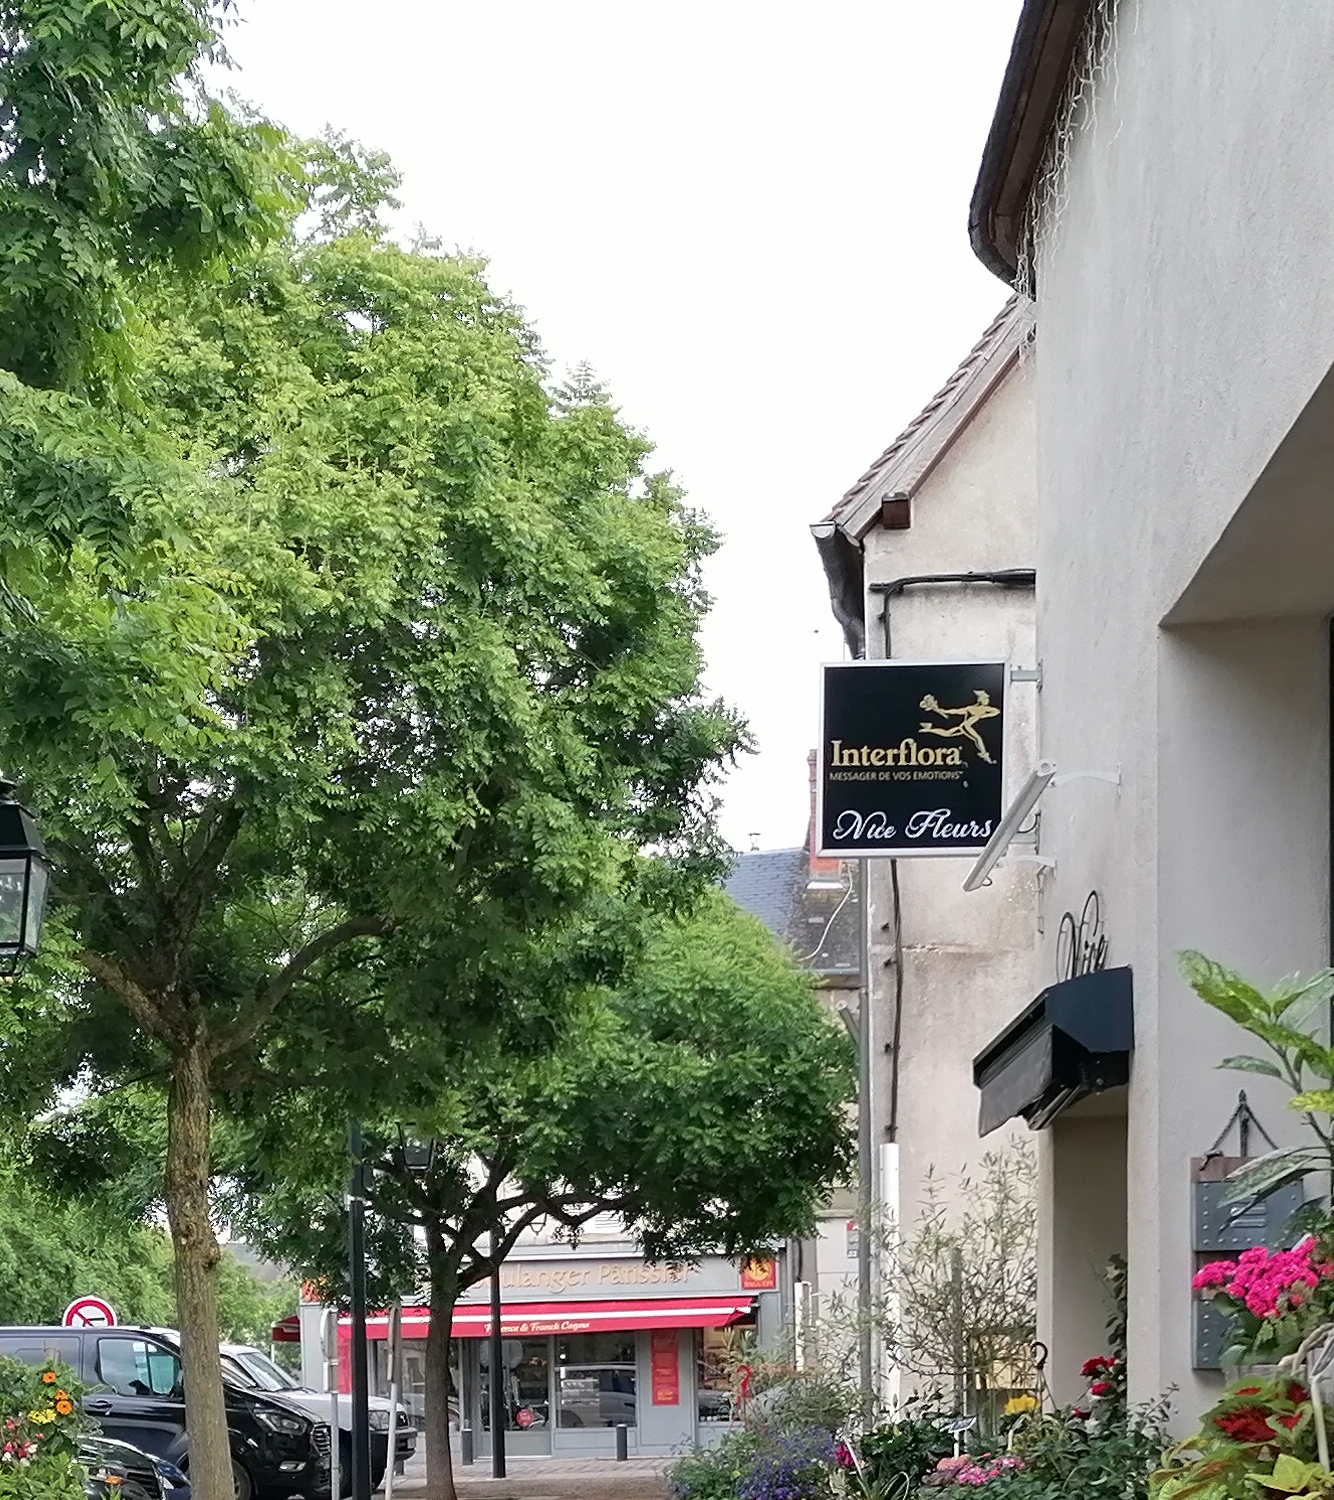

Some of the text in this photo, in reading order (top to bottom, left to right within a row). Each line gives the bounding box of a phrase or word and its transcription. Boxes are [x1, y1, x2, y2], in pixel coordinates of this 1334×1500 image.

[830, 738, 964, 767] Interflora
[829, 771, 877, 782] MESSAGER
[878, 771, 891, 781] DE
[893, 771, 912, 781] VOS
[832, 808, 993, 840] Nice Fleurs
